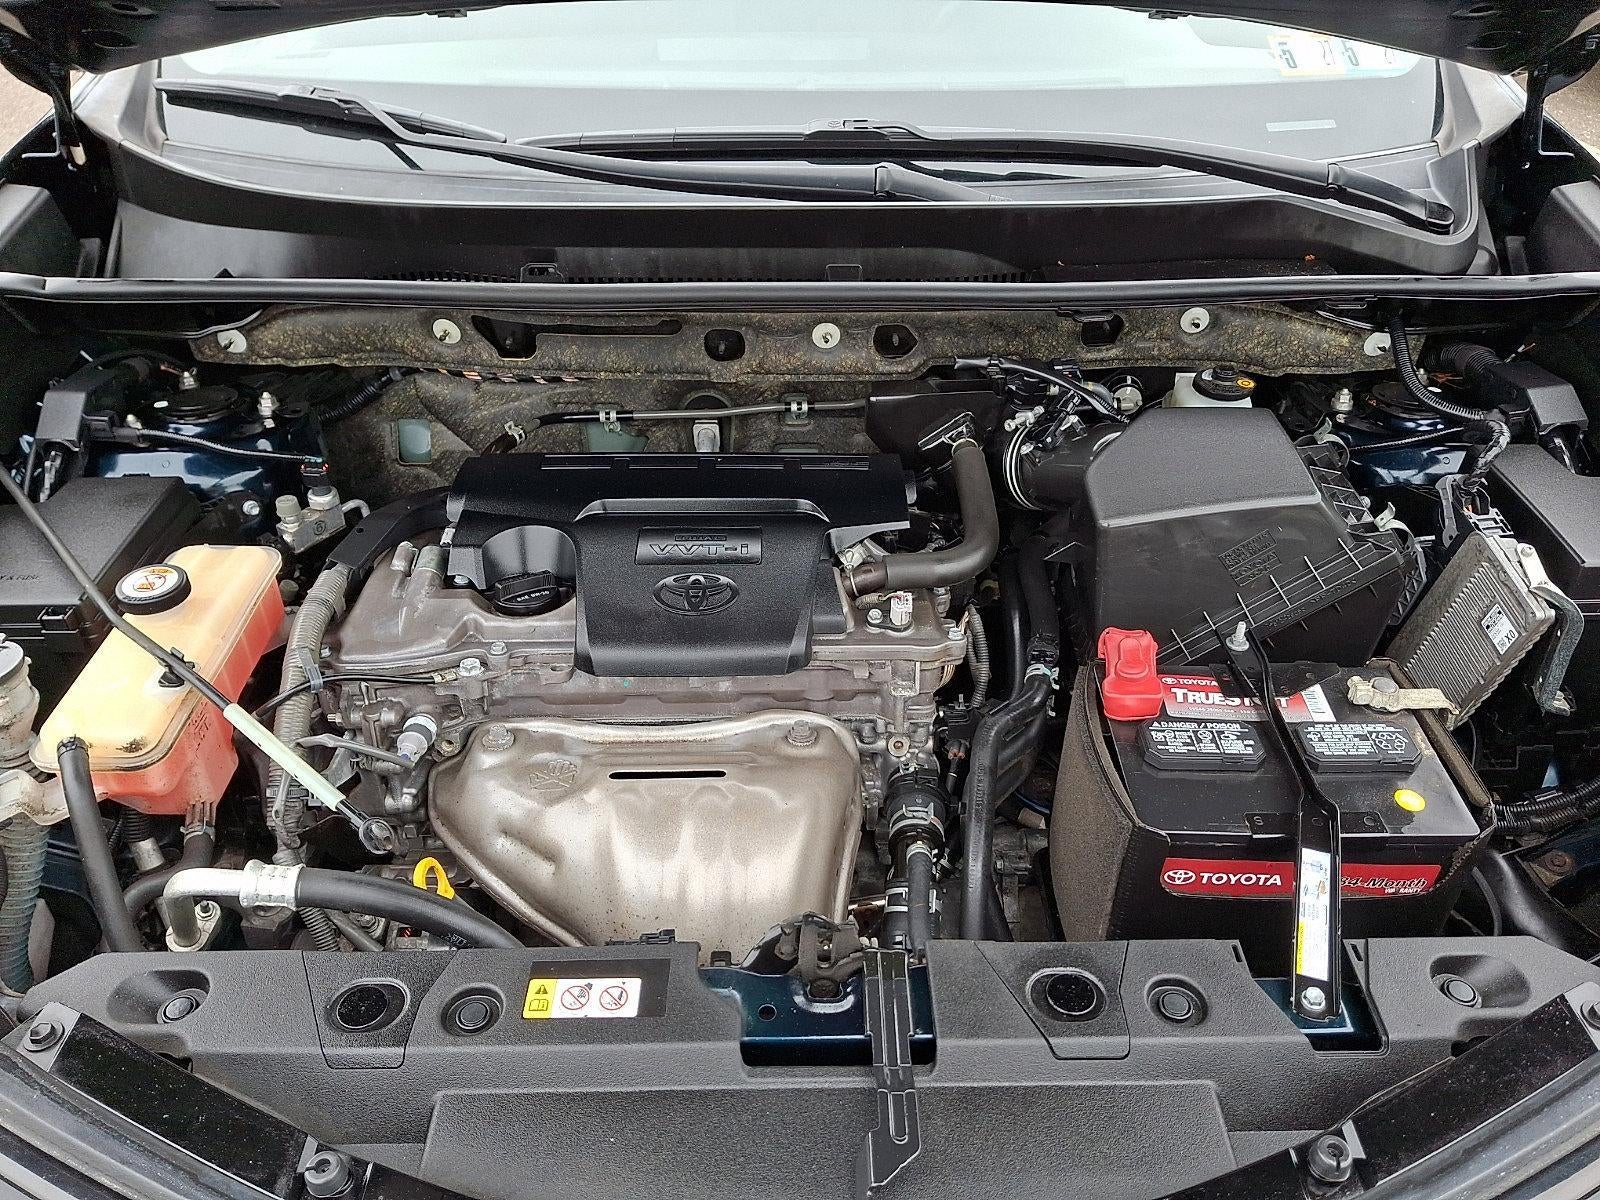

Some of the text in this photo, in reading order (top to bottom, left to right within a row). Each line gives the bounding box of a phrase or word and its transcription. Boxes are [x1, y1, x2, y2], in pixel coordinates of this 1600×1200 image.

[649, 543, 749, 556] VVT-i
[1176, 678, 1219, 687] TOYOTA
[1160, 721, 1199, 729] DANGER
[1206, 722, 1241, 731] POISON
[1199, 872, 1282, 886] TOYOTA
